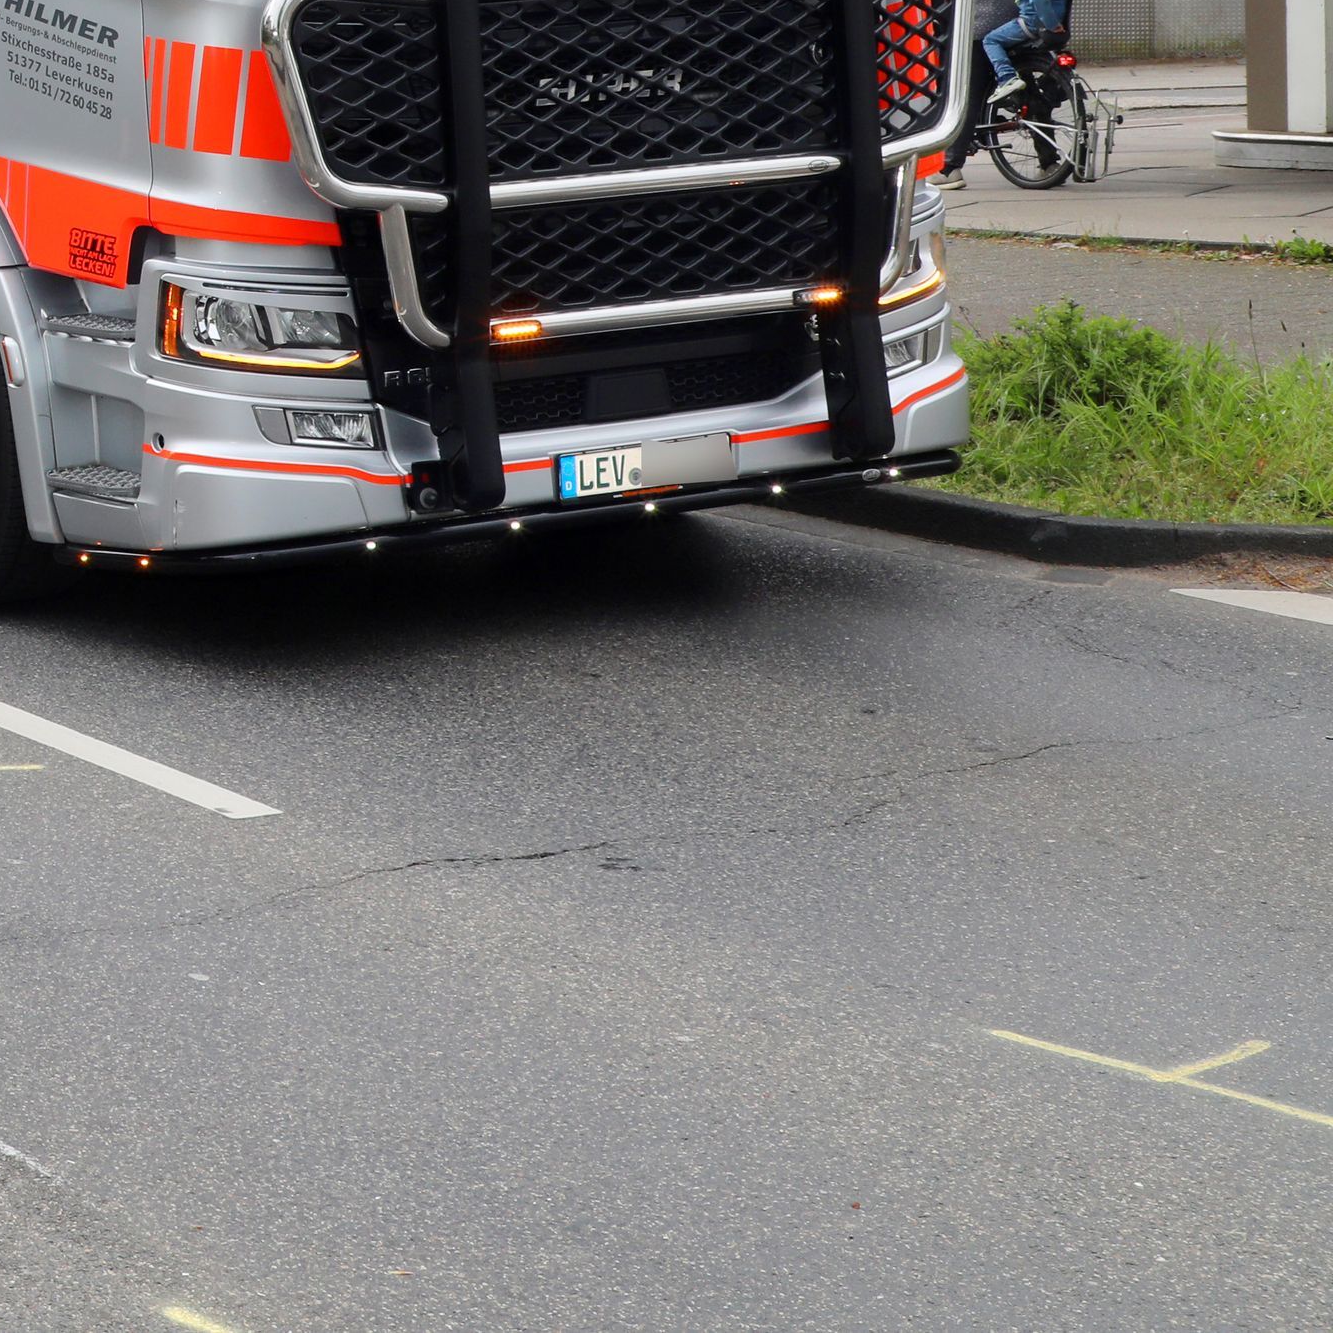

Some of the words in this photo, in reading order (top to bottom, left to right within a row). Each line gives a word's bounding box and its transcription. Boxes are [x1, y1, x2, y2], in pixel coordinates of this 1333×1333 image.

[1, 31, 82, 71] Stixchesstraße
[86, 63, 115, 83] 185a
[51, 33, 117, 64] Abschleppdienst
[7, 51, 42, 72] 51377
[45, 66, 113, 101] Leverkusen
[70, 255, 115, 277] LECKEN!
[565, 481, 573, 491] D
[579, 455, 625, 491] LEV
